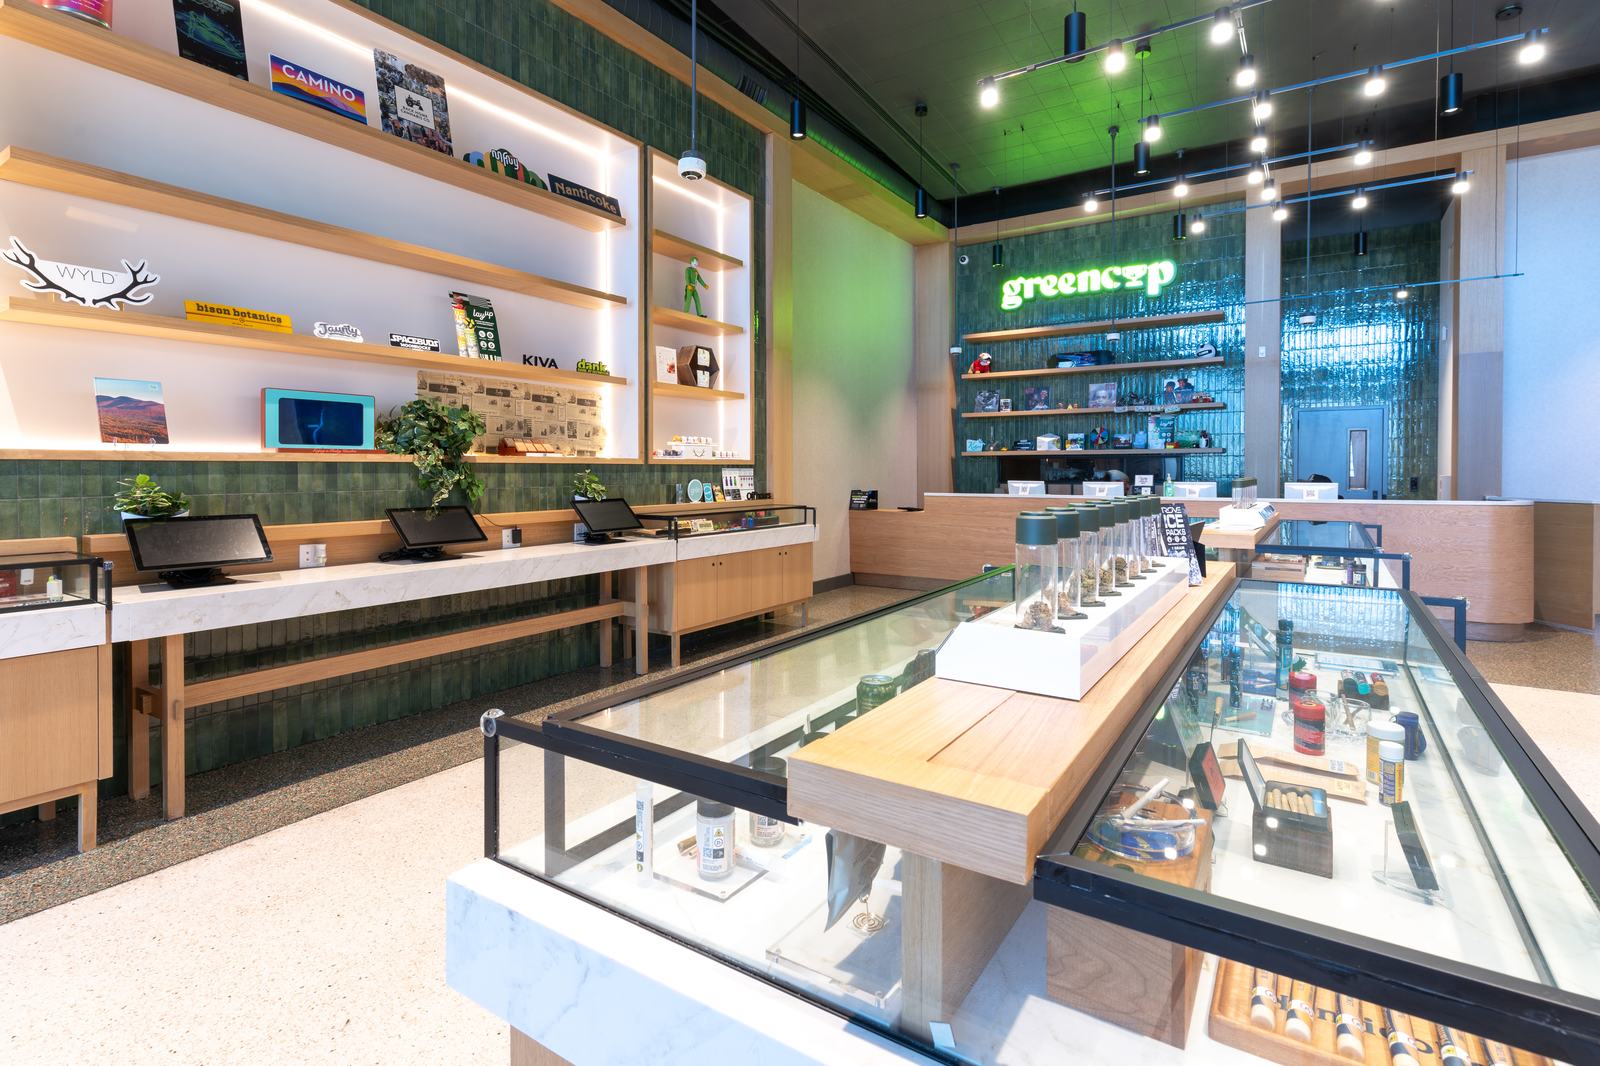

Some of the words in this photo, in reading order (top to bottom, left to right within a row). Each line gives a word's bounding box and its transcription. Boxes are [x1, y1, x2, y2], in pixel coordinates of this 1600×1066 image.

[282, 64, 355, 101] CAMINO
[554, 182, 617, 214] Nanticoke
[56, 265, 115, 285] WYLD
[195, 302, 231, 316] bison
[233, 306, 282, 324] botanics
[318, 323, 360, 338] Jaunty
[390, 334, 439, 347] SPACEBUDS
[522, 354, 559, 369] KIVA
[1160, 506, 1182, 514] ROVE
[1163, 513, 1185, 529] ICE
[1165, 528, 1187, 536] PACKS
